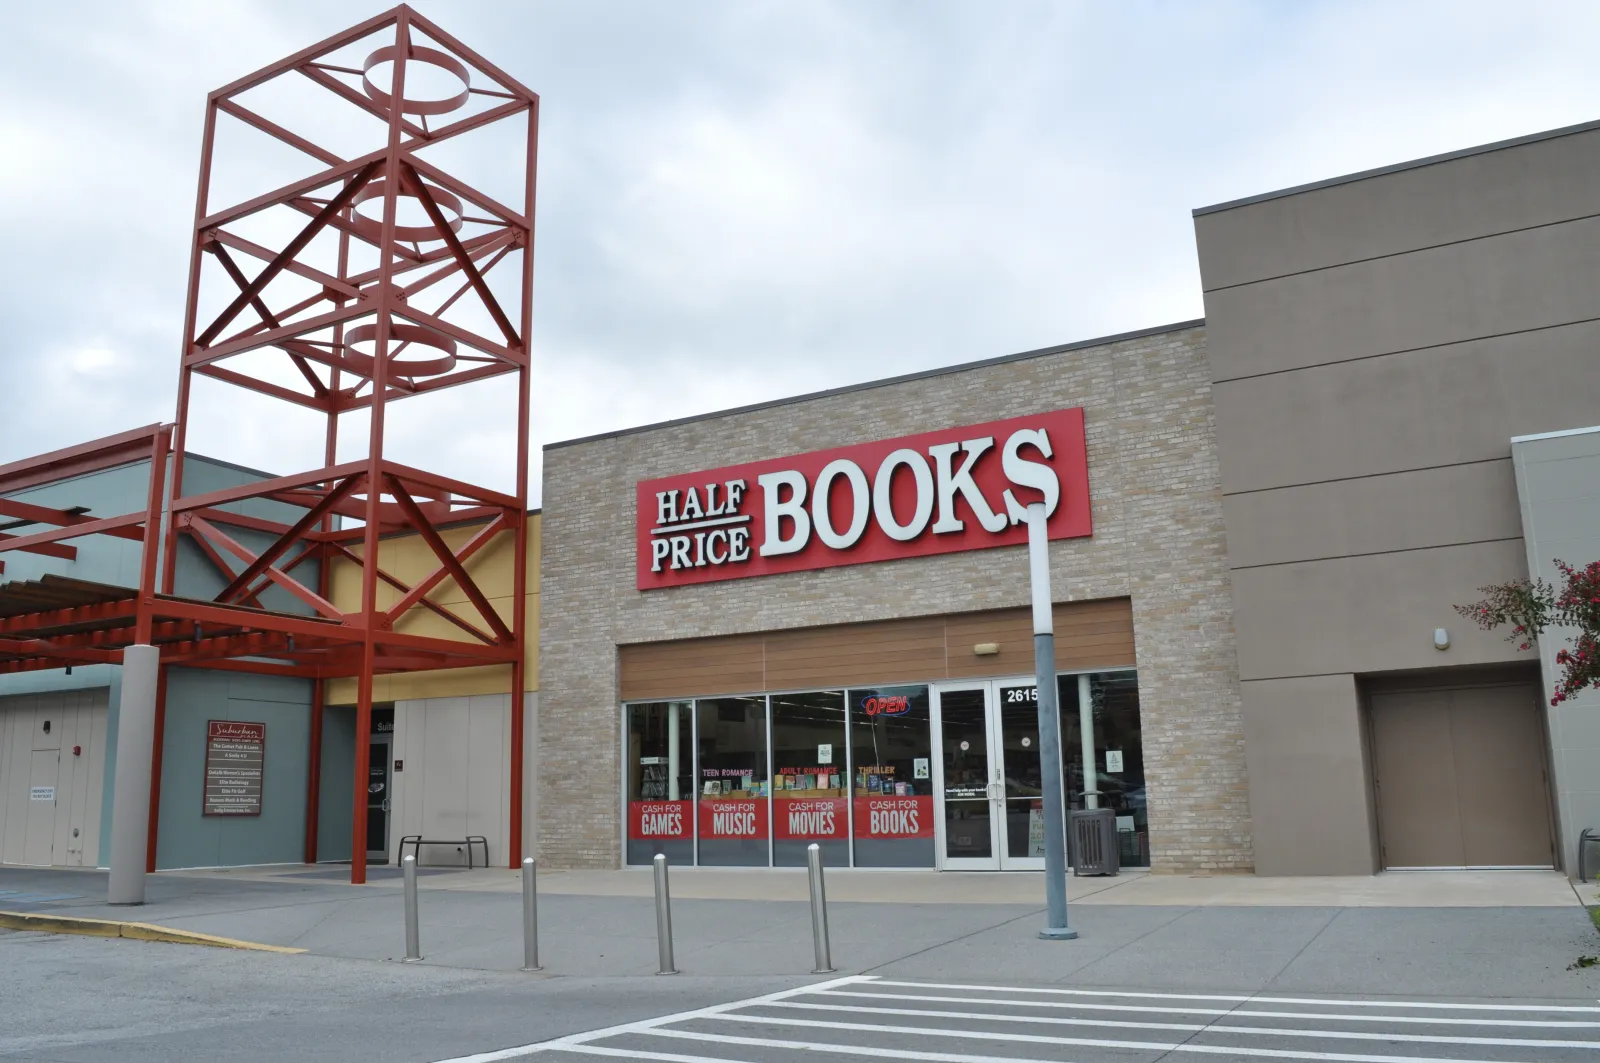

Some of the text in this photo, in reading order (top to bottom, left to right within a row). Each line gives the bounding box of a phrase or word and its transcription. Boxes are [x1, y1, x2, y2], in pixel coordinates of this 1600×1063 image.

[656, 479, 746, 525] HALF
[757, 428, 1060, 558] BOOKS
[650, 527, 750, 573] PRICE
[866, 696, 907, 716] OPEN
[1007, 689, 1038, 702] 2615
[217, 724, 257, 735] Suburban
[642, 804, 682, 813] CASH FOR
[713, 804, 736, 812] CASH
[789, 802, 834, 811] CASH FOR
[870, 800, 918, 810] CASH FOR
[642, 813, 682, 835] GAMES
[714, 813, 756, 835] MUSIC
[789, 811, 835, 834] MOVIES
[870, 810, 919, 834] BOOKS
